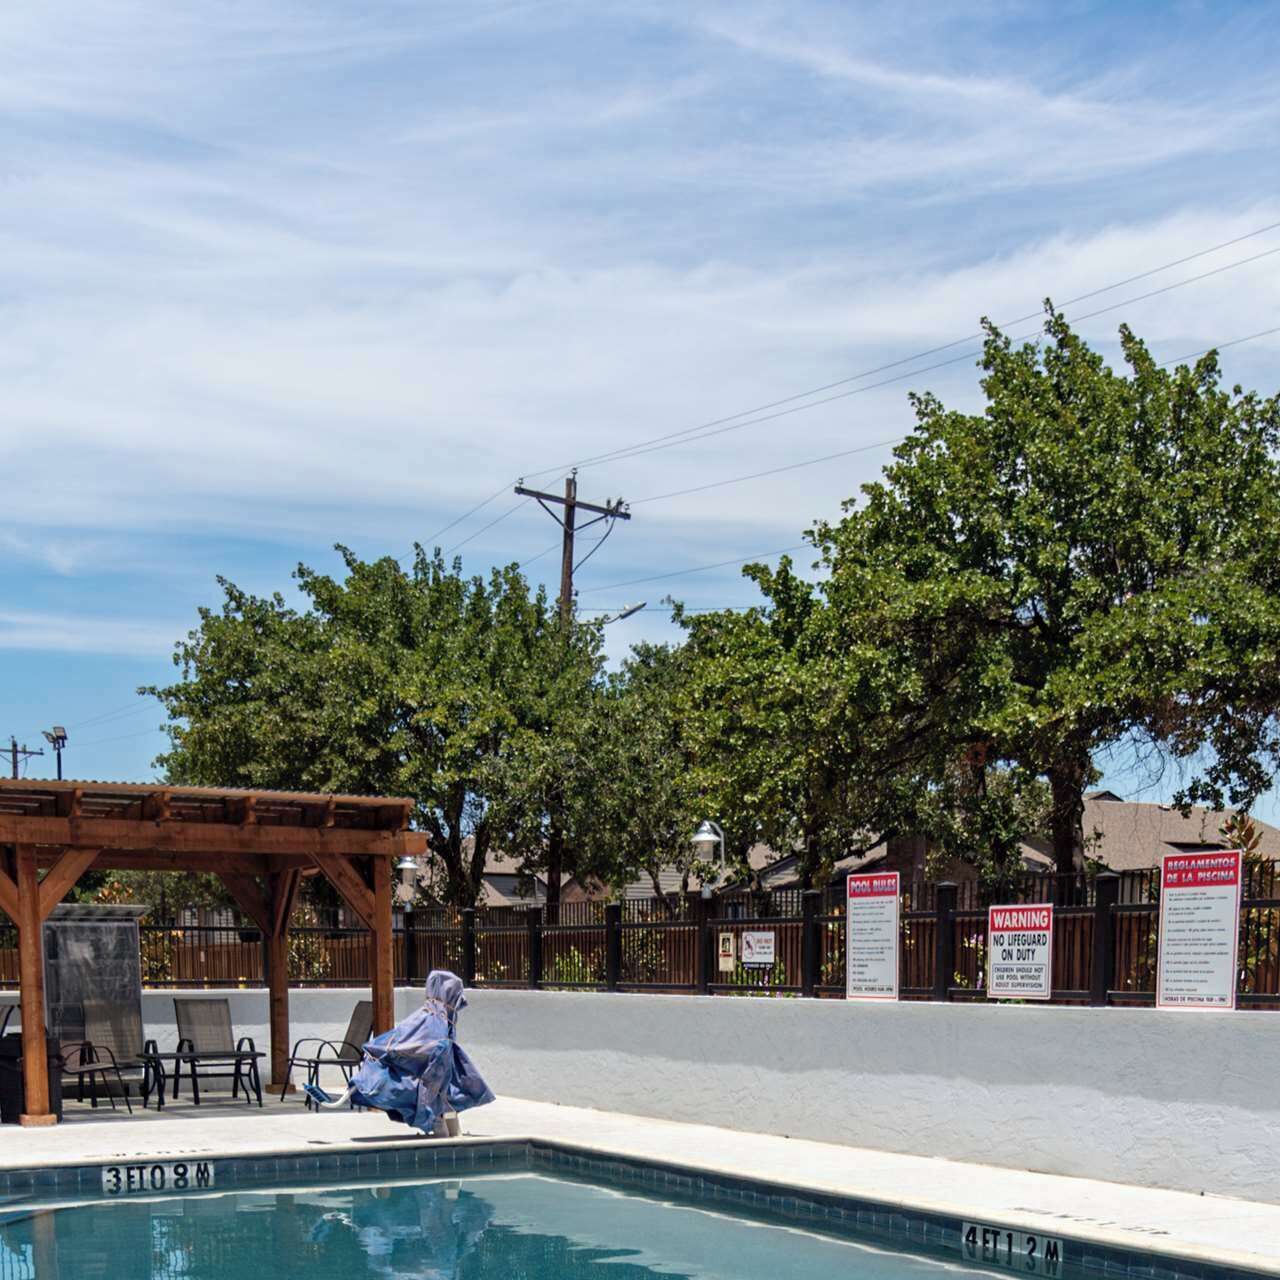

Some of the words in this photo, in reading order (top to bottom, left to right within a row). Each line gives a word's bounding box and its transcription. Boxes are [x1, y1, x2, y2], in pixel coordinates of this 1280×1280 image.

[1167, 857, 1236, 870] REGLAMENTOS
[1166, 873, 1178, 883] DE
[1182, 872, 1194, 882] LA
[1197, 870, 1235, 882] PISCINA
[850, 880, 871, 893] POOL
[872, 878, 897, 892] RULES
[993, 911, 1049, 929] WARNING
[993, 934, 1005, 946] NO
[1007, 934, 1048, 946] LIFEGUARD
[1001, 949, 1013, 961] ON
[1016, 949, 1036, 961] DUTY
